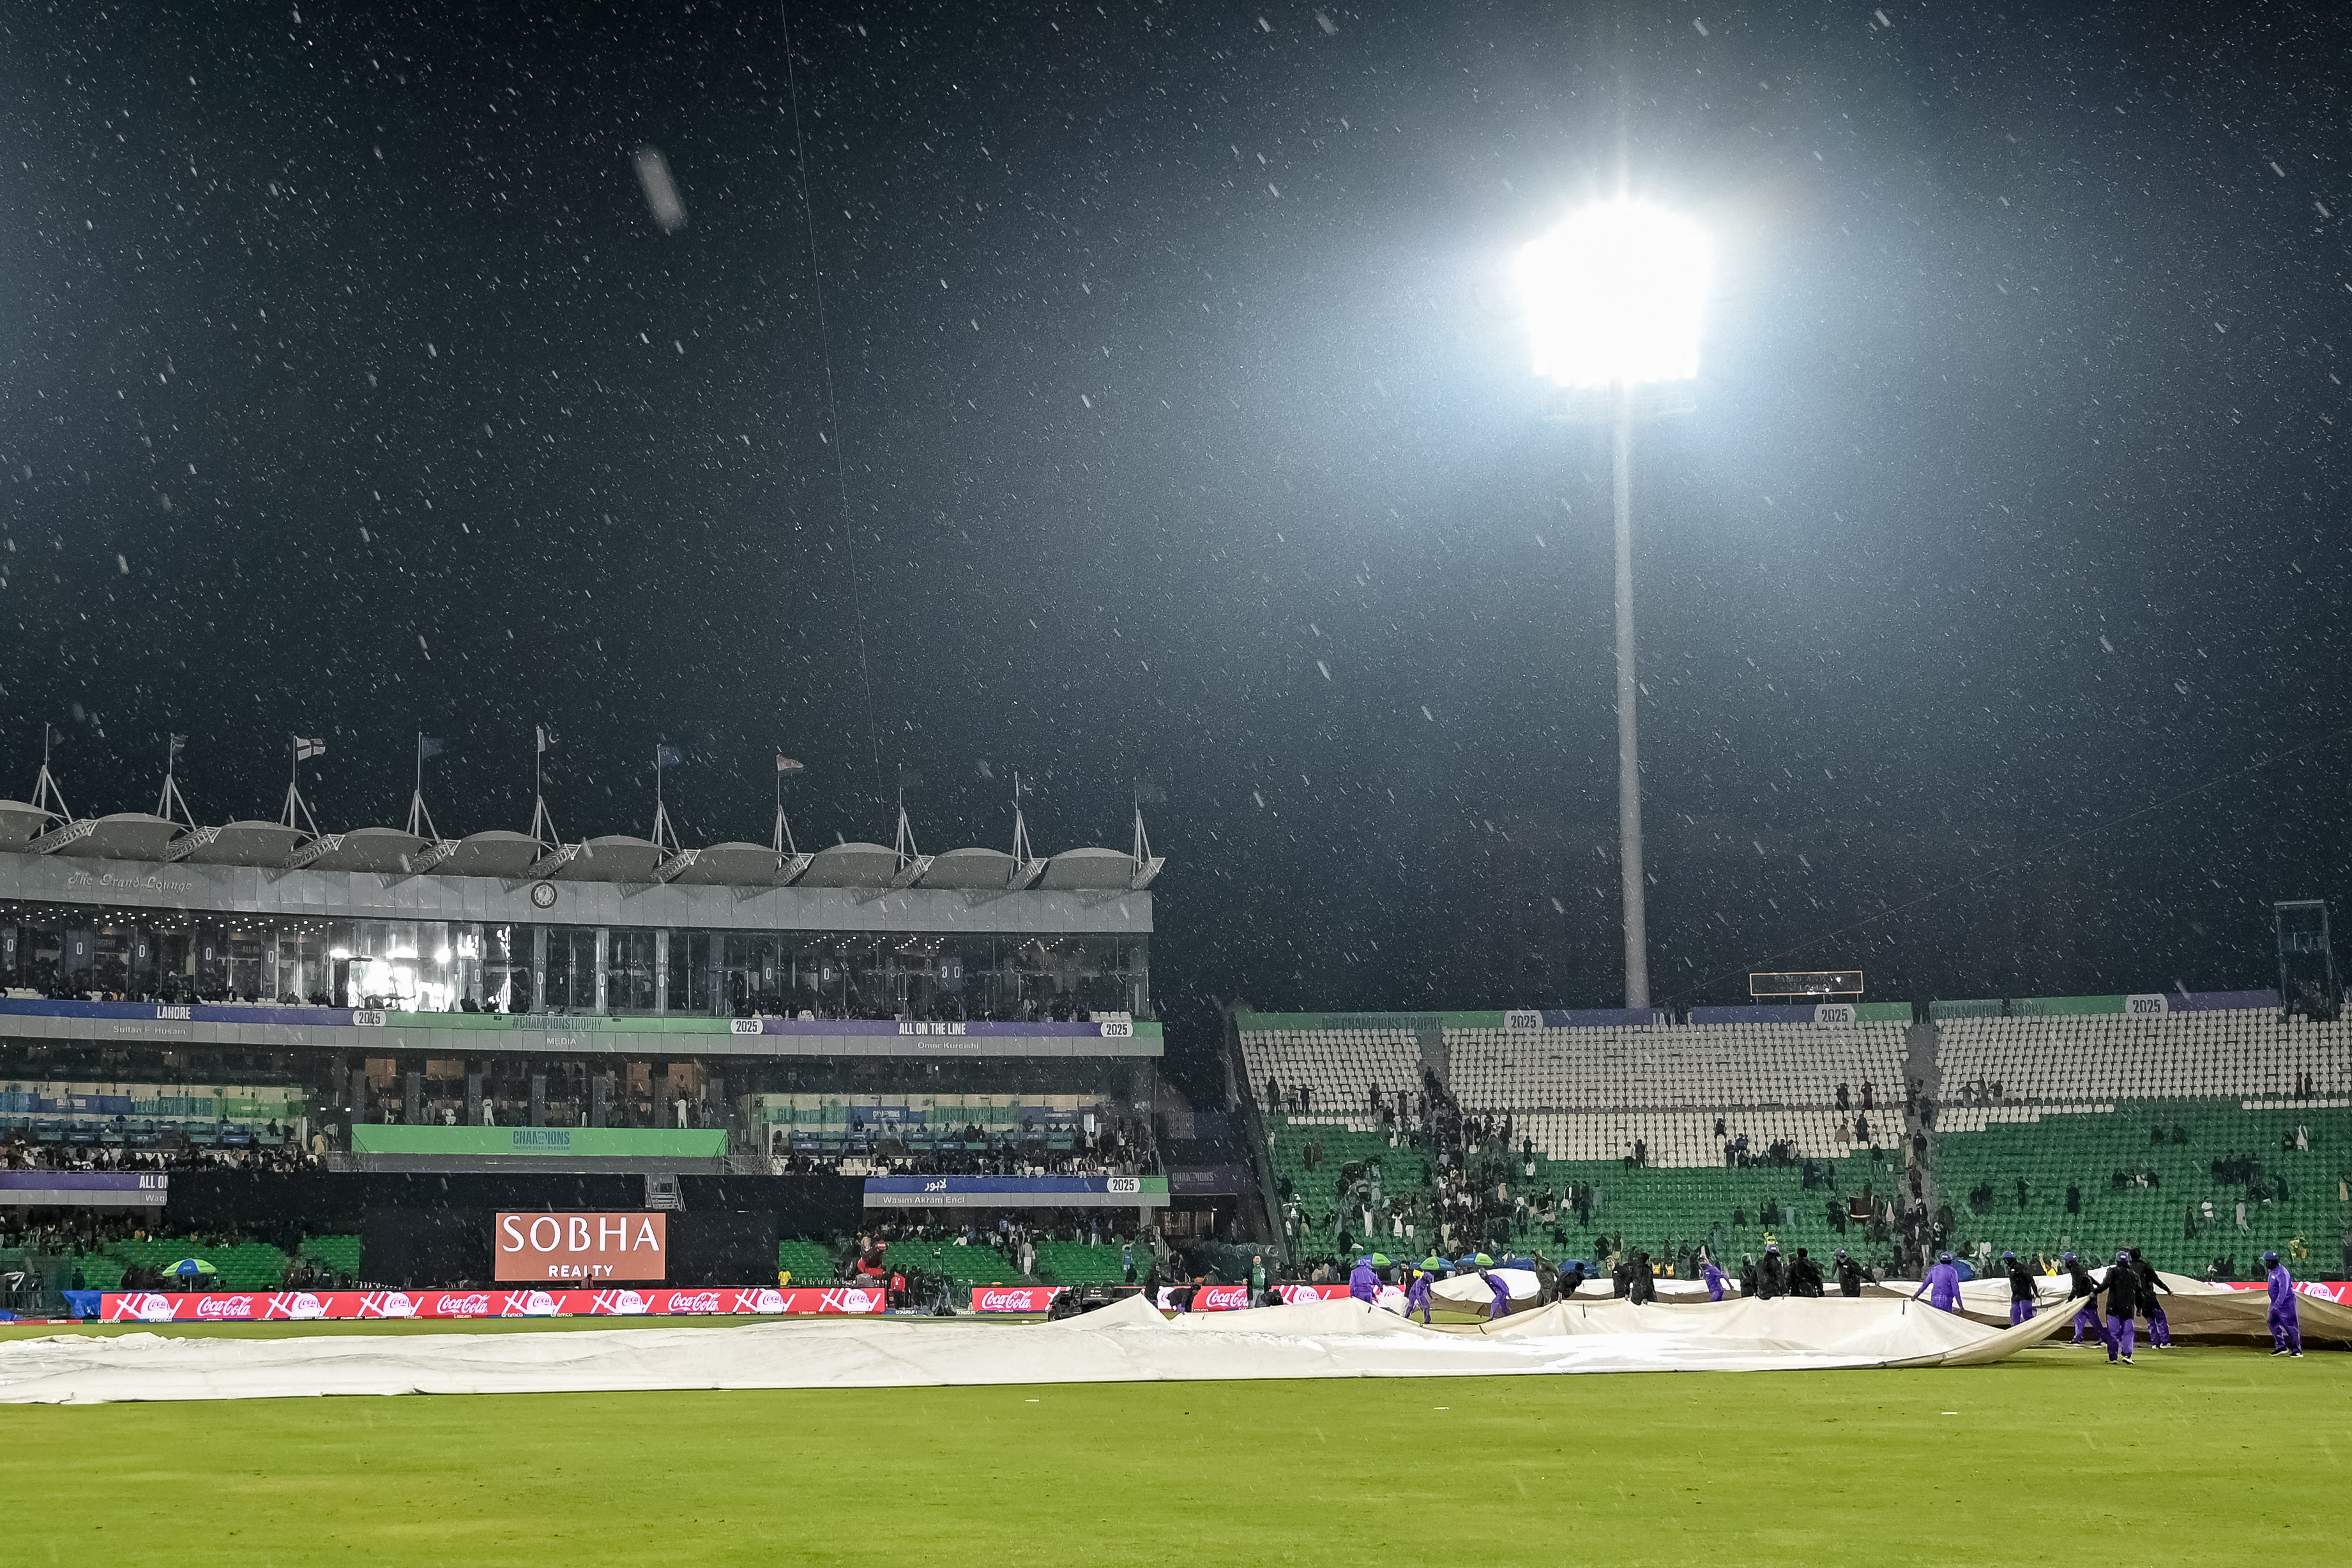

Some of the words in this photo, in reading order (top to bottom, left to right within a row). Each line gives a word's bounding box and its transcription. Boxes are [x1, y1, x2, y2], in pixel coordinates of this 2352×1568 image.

[68, 871, 93, 886] The
[99, 873, 140, 888] Grand
[142, 876, 192, 894] Lounge
[156, 1006, 191, 1020] LAHORE
[2132, 1000, 2162, 1014] 2025
[358, 1011, 381, 1025] 2025
[1511, 1014, 1537, 1029] 2025
[1821, 1008, 1848, 1023] 2025
[512, 1016, 602, 1031] #CHAMPIONSTROPHY
[735, 1020, 757, 1033] 2025
[899, 1023, 913, 1036] ALL
[916, 1023, 928, 1036] ON
[930, 1023, 946, 1036] THE
[948, 1023, 966, 1036] LINE
[1106, 1024, 1128, 1036] 2025
[547, 1037, 577, 1046] MEDIA
[139, 1175, 155, 1189] ALL
[1111, 1179, 1134, 1191] 2025
[883, 1196, 912, 1204] Wasim
[914, 1196, 943, 1204] Akram
[945, 1196, 965, 1204] Encl
[503, 1216, 660, 1252] SOBHA
[549, 1265, 613, 1278] REALTY
[1206, 1288, 1248, 1307] Coca-Col
[1299, 1290, 1317, 1301] Coca
[2310, 1287, 2330, 1297] Coca
[148, 1299, 167, 1311] Coca
[298, 1297, 317, 1309] Coca
[390, 1297, 408, 1309] Coca
[533, 1296, 551, 1307] Coca
[622, 1295, 640, 1307] Coca
[763, 1293, 780, 1305] Coca
[849, 1293, 868, 1305] Coca
